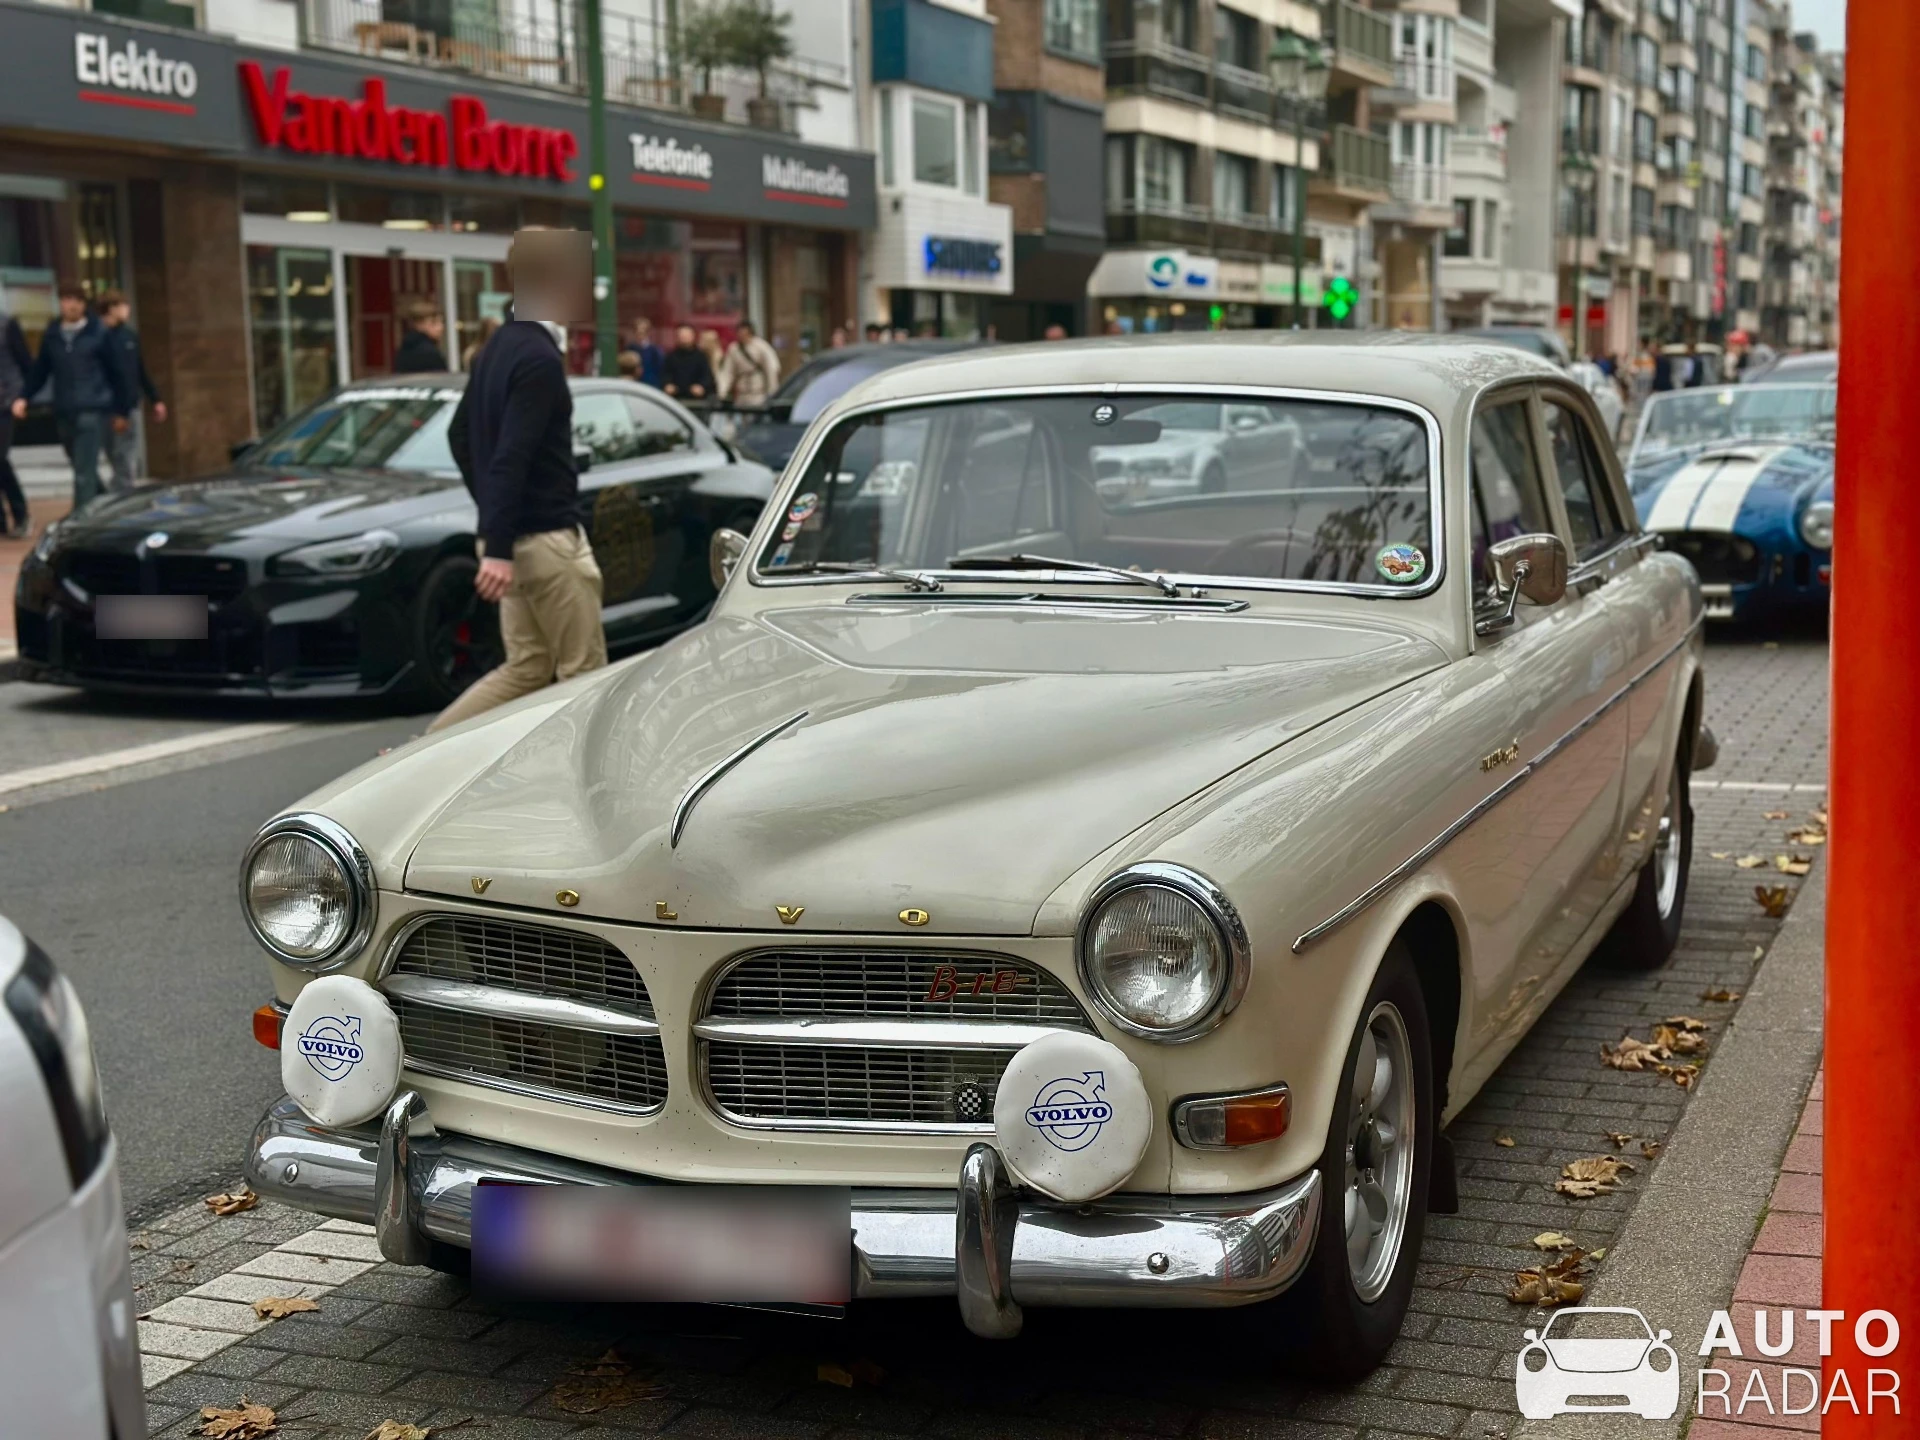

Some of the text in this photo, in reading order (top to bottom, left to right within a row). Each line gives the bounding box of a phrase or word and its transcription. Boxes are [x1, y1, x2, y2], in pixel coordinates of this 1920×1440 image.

[75, 32, 198, 98] Elektro
[238, 60, 580, 182] Vanden Borre
[629, 133, 713, 180] Telefonie
[762, 154, 849, 198] Multimedia
[471, 876, 930, 926] VOLVO
[301, 1040, 360, 1060] VOLVO
[1029, 1106, 1108, 1122] VOLVO
